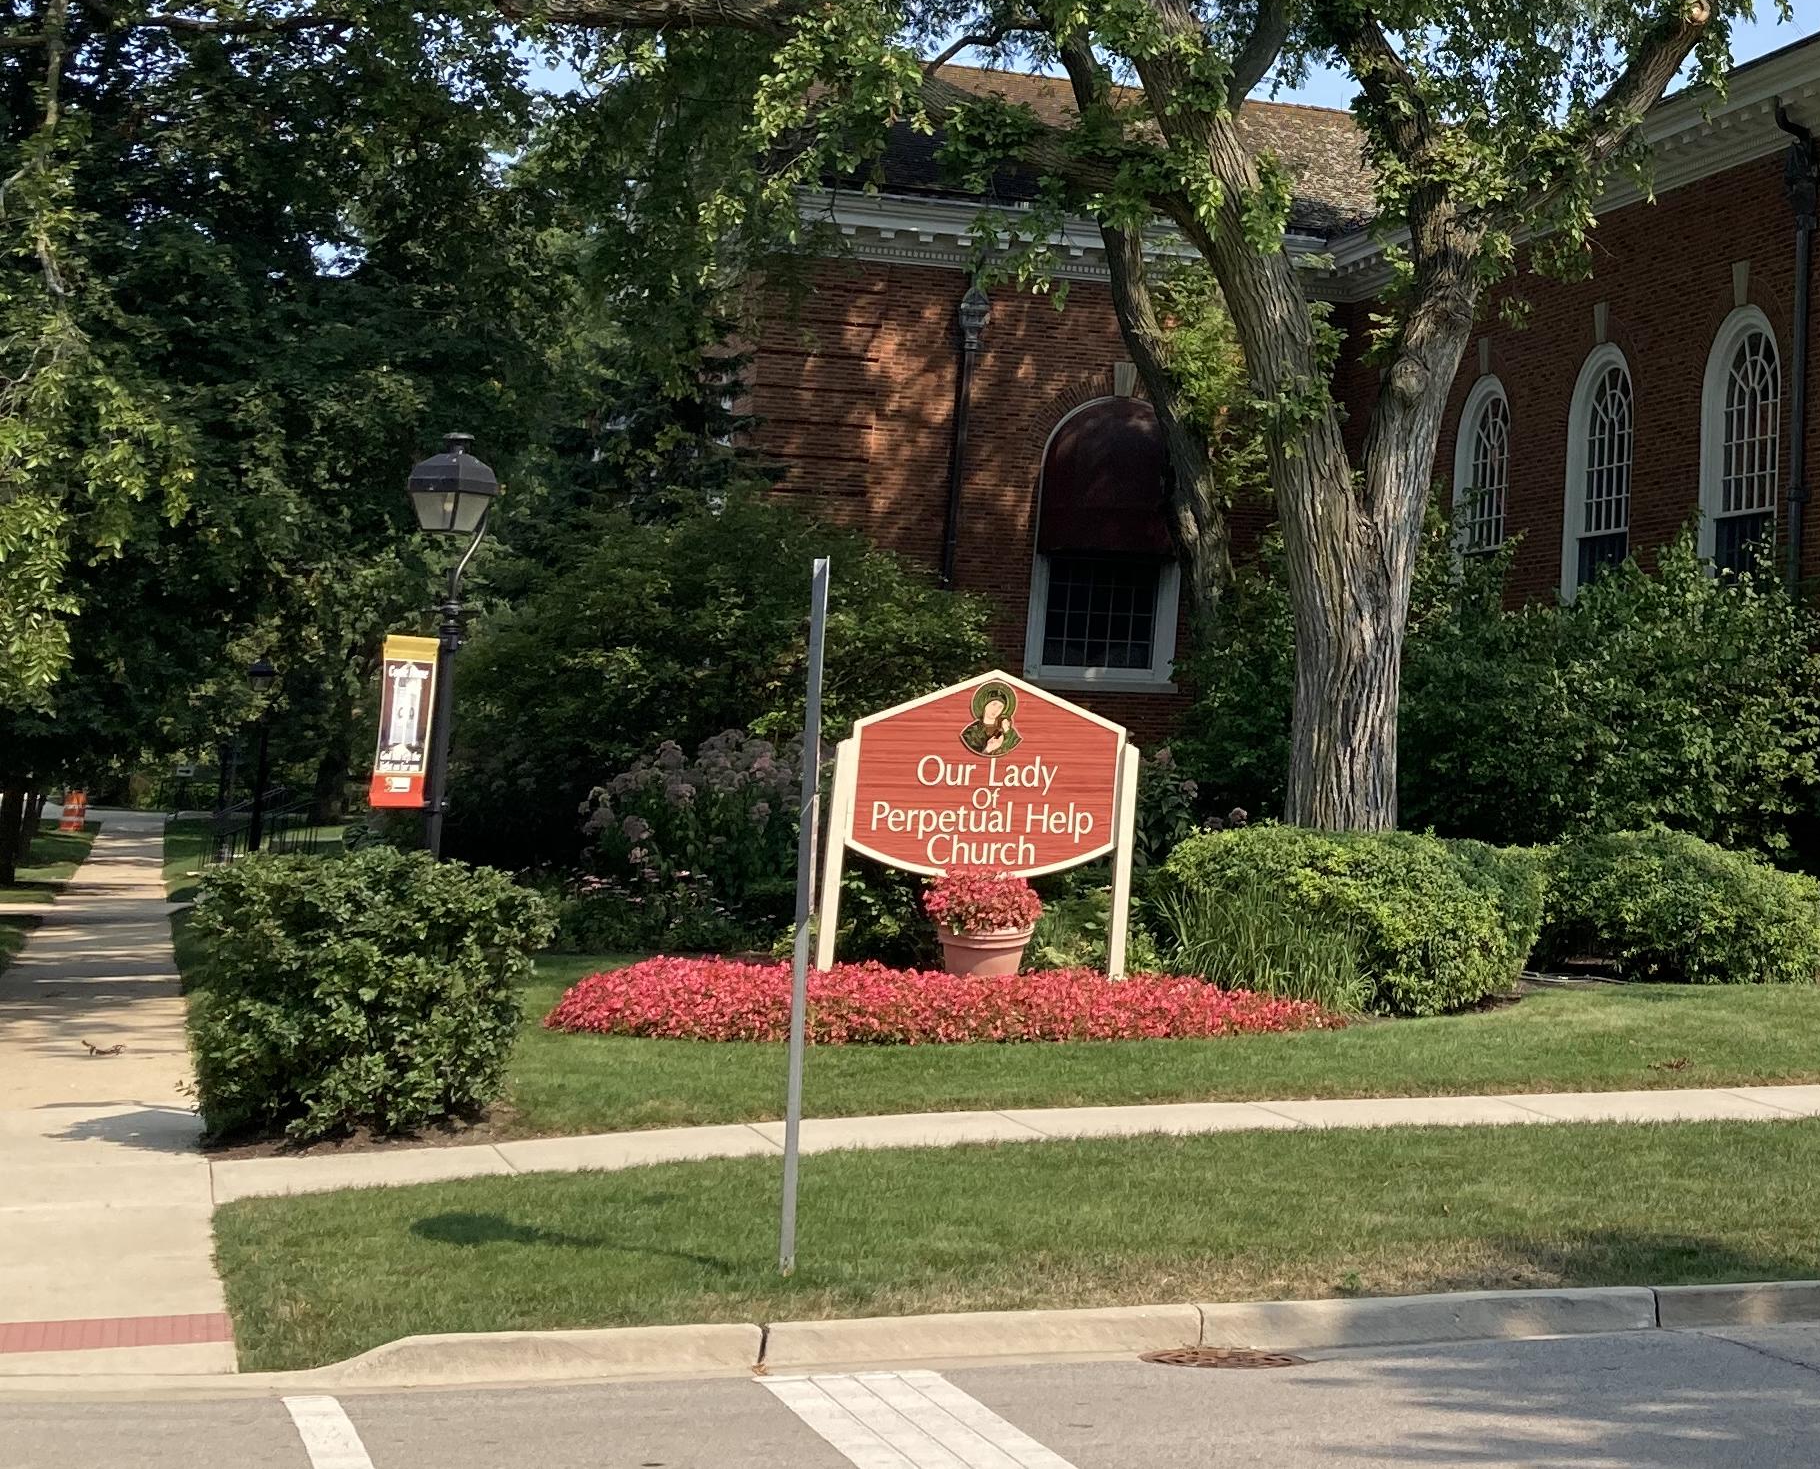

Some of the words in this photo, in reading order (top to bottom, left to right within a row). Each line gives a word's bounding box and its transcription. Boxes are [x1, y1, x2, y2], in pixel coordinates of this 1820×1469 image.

[917, 754, 977, 786] Our
[988, 755, 1059, 796] Lady
[971, 787, 1001, 810] Of
[870, 800, 1014, 840] Perpetual
[1025, 803, 1094, 844] Help
[926, 833, 1036, 866] Church
